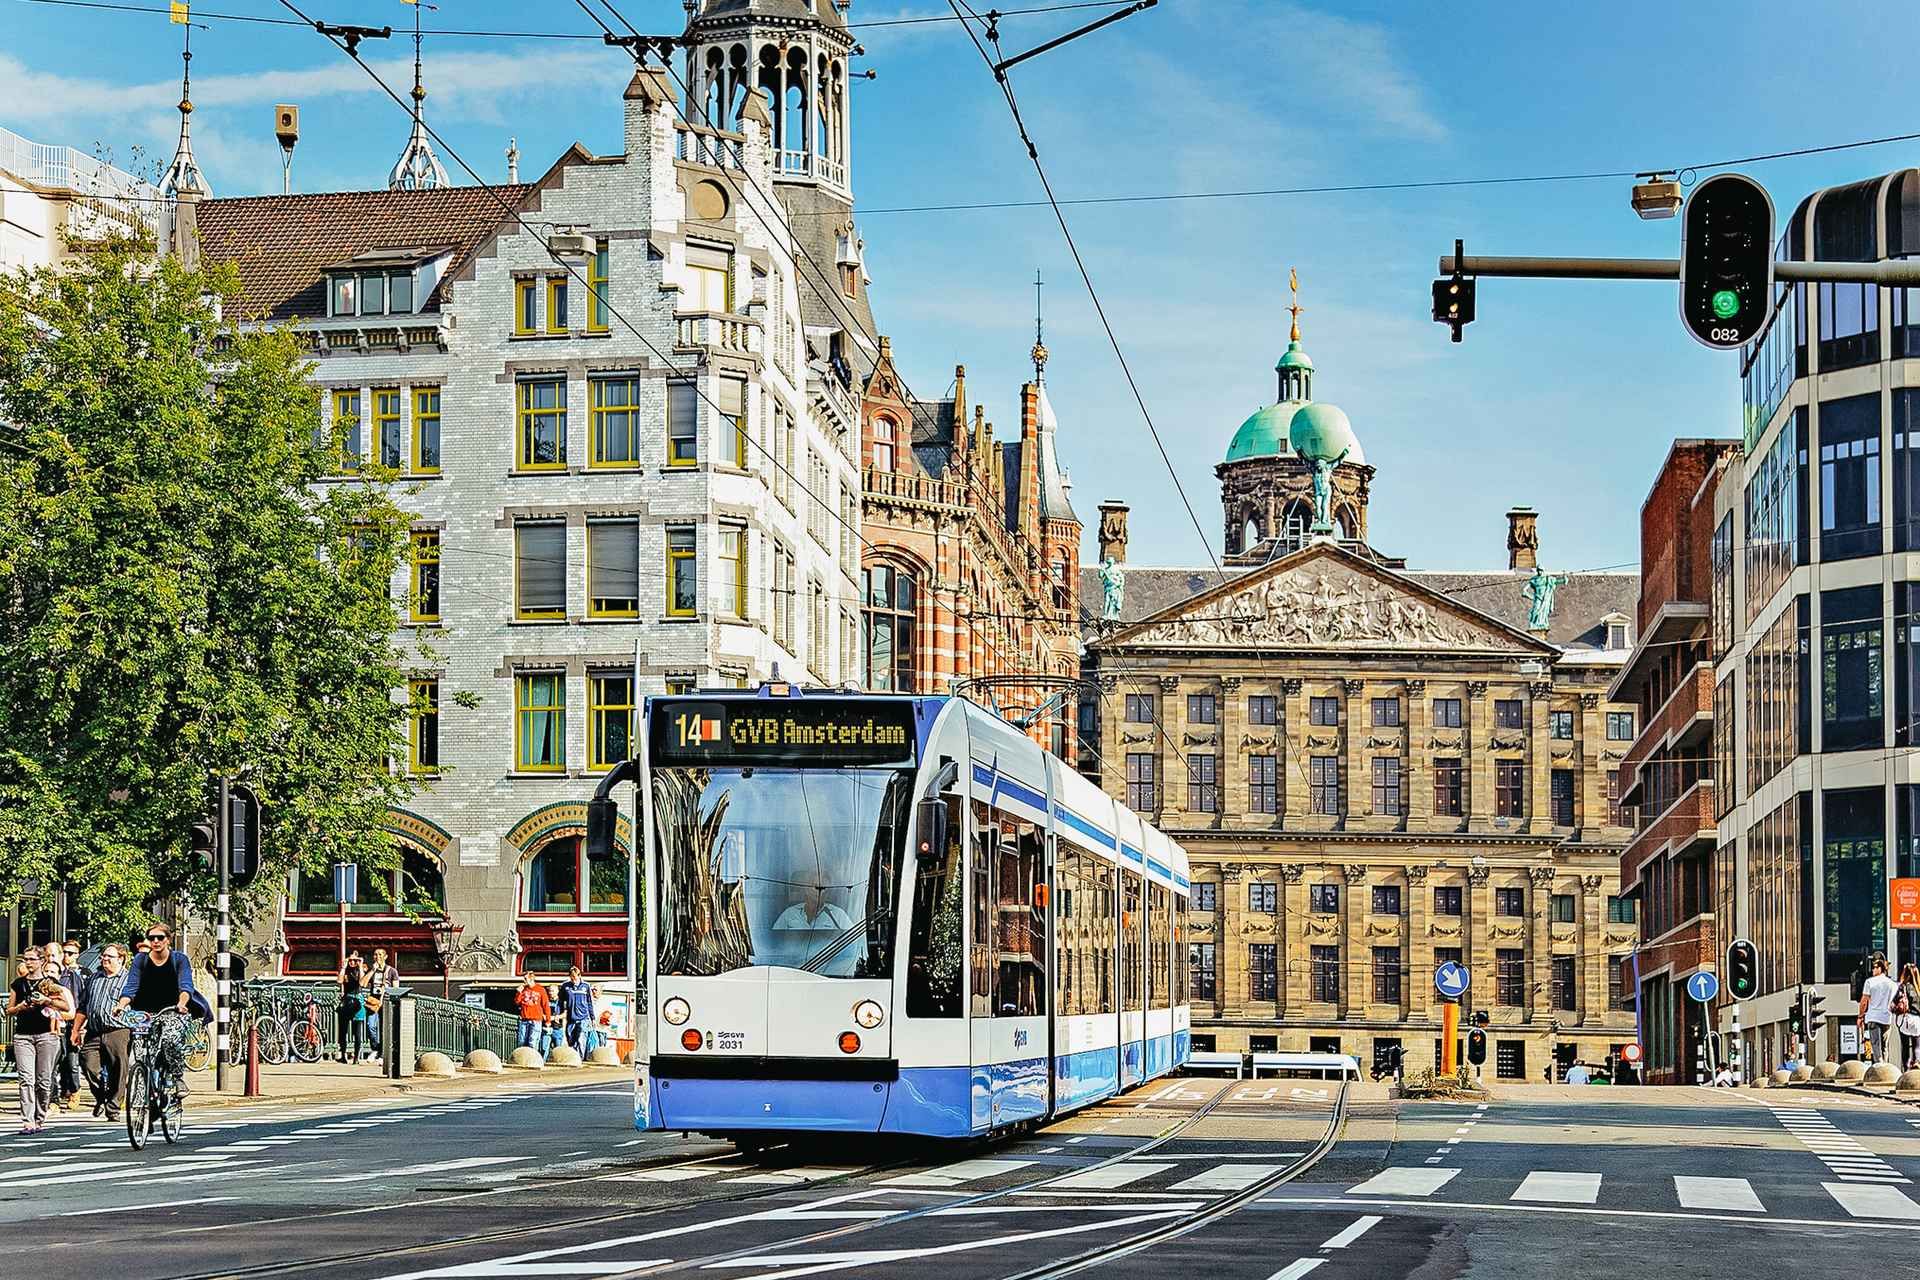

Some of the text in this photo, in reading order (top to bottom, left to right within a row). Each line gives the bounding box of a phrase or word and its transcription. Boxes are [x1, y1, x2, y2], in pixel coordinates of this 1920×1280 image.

[1711, 328, 1739, 341] 082
[675, 713, 905, 747] 14 GVB Amsterdam
[719, 1040, 743, 1049] 2031
